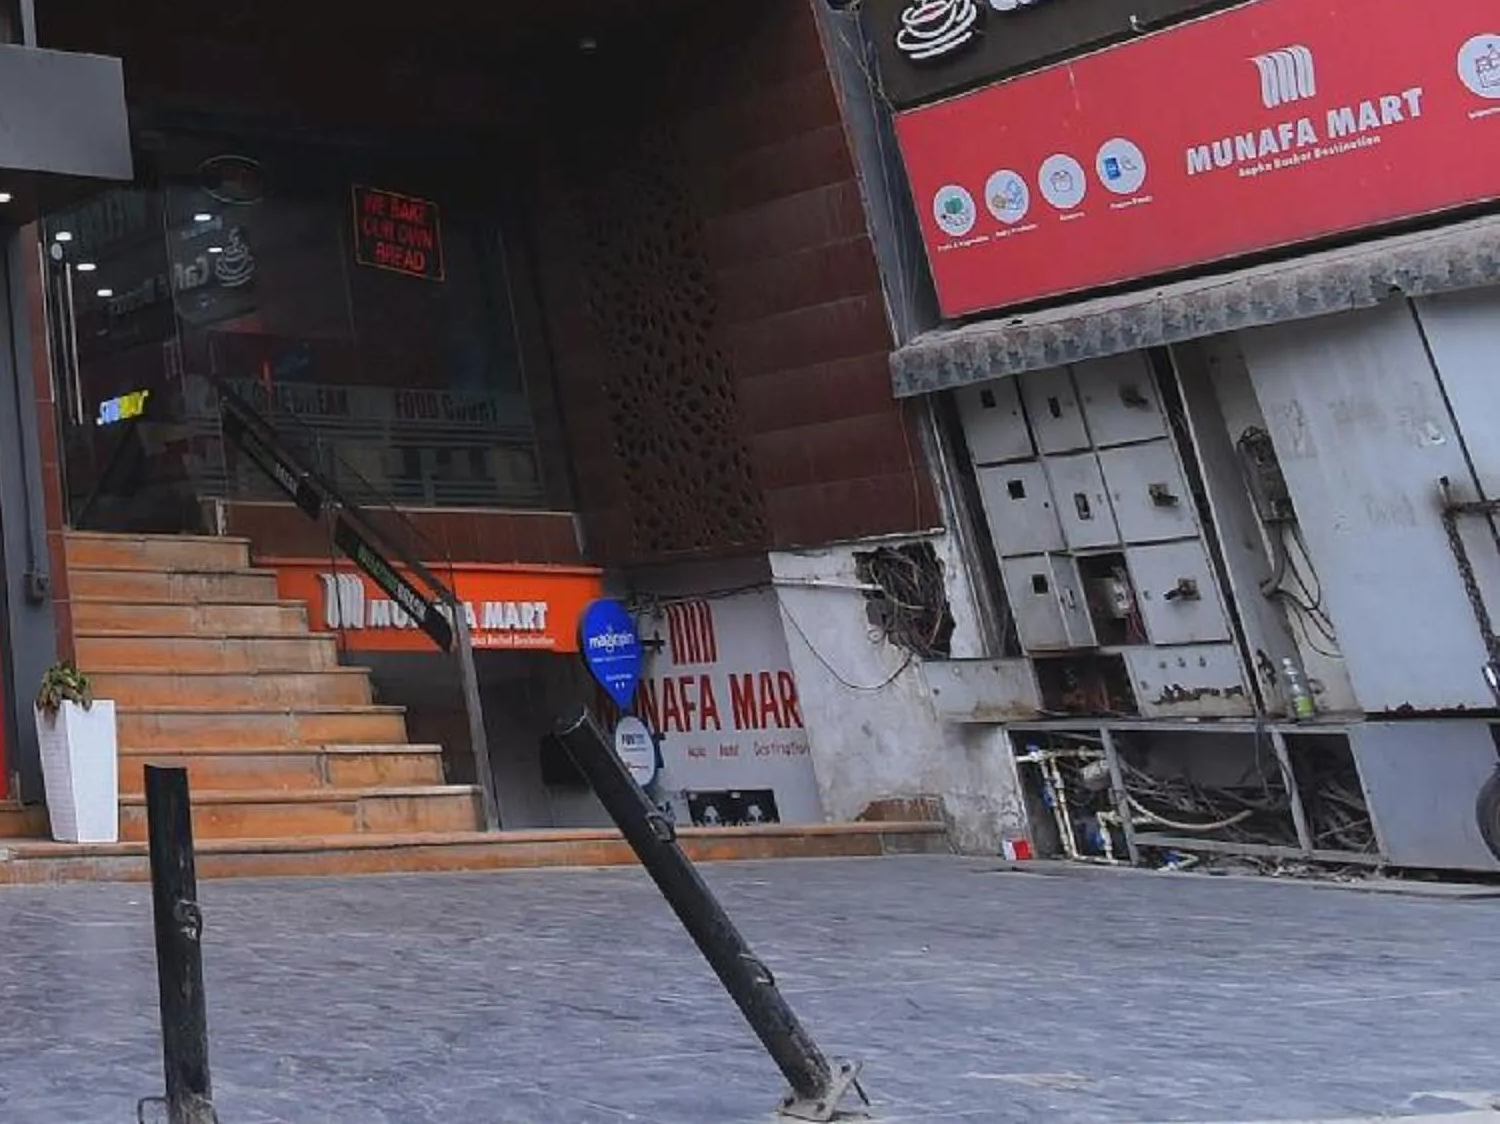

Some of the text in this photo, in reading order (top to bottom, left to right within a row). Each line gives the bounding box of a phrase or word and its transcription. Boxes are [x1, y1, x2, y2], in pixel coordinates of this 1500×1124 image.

[1186, 87, 1423, 176] MUNAFA MART
[481, 601, 547, 630] MART
[608, 674, 721, 733] NAFA
